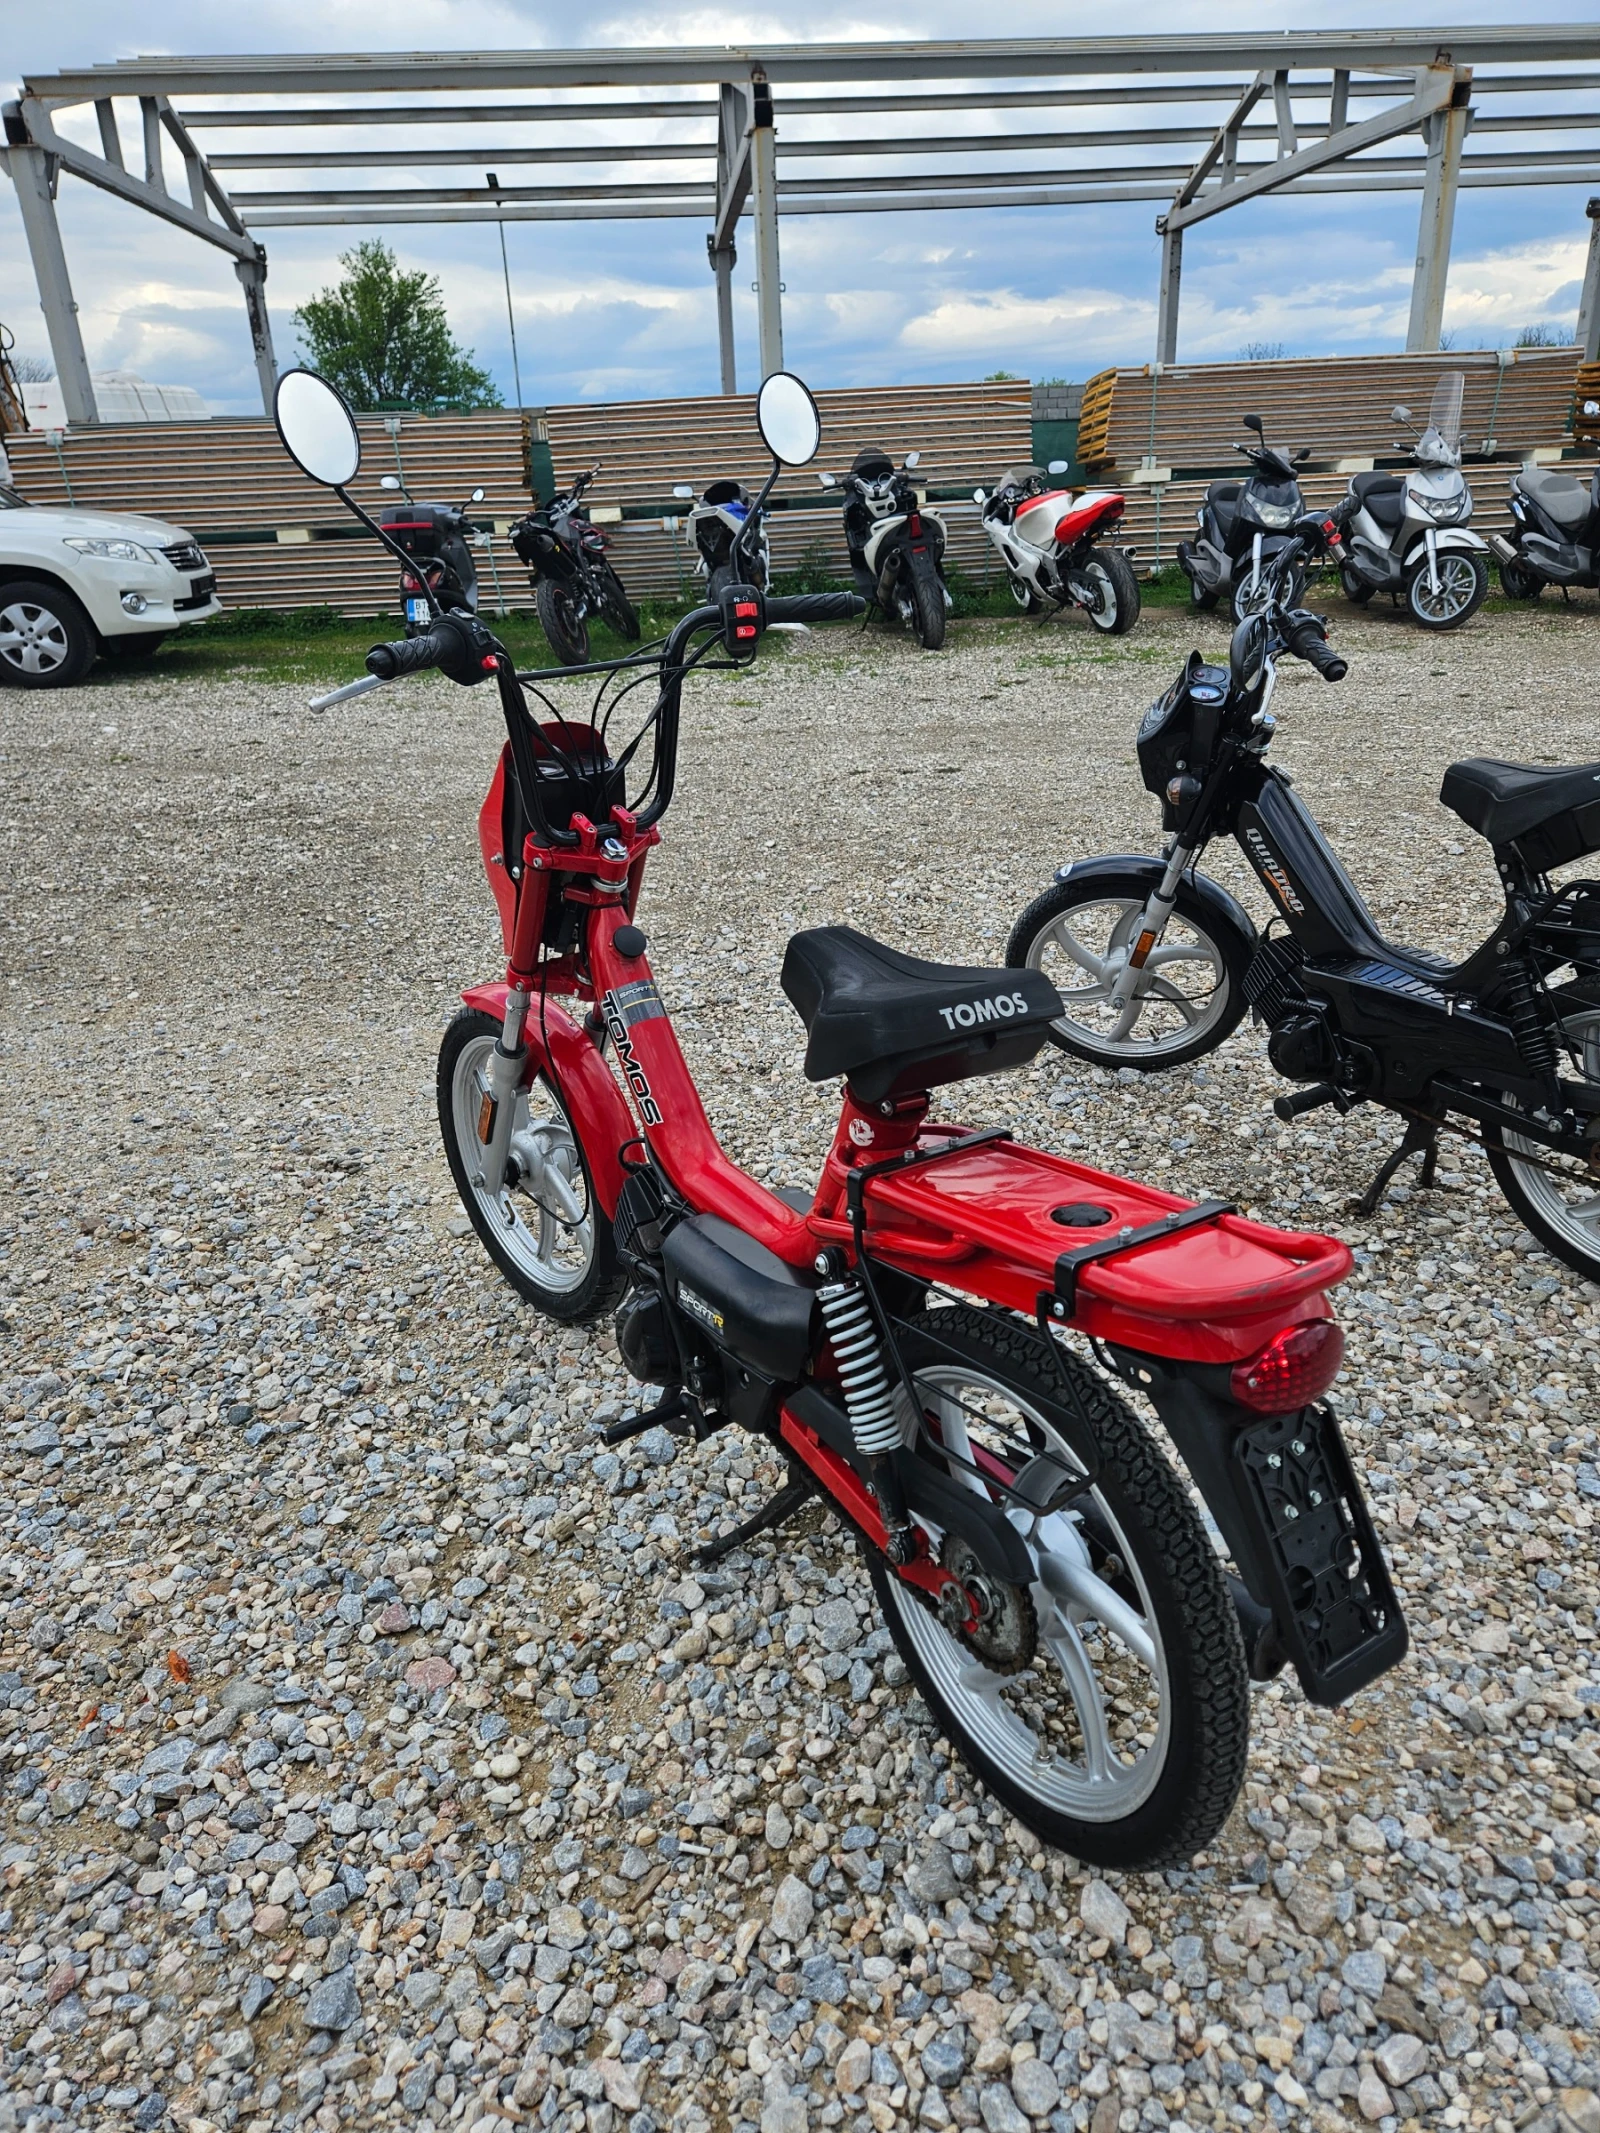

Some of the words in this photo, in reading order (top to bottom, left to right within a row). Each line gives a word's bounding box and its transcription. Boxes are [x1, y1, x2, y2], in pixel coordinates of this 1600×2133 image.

[1246, 828, 1305, 912] QUADRO
[939, 992, 1029, 1030] TOMOS
[602, 990, 664, 1126] TOMOS
